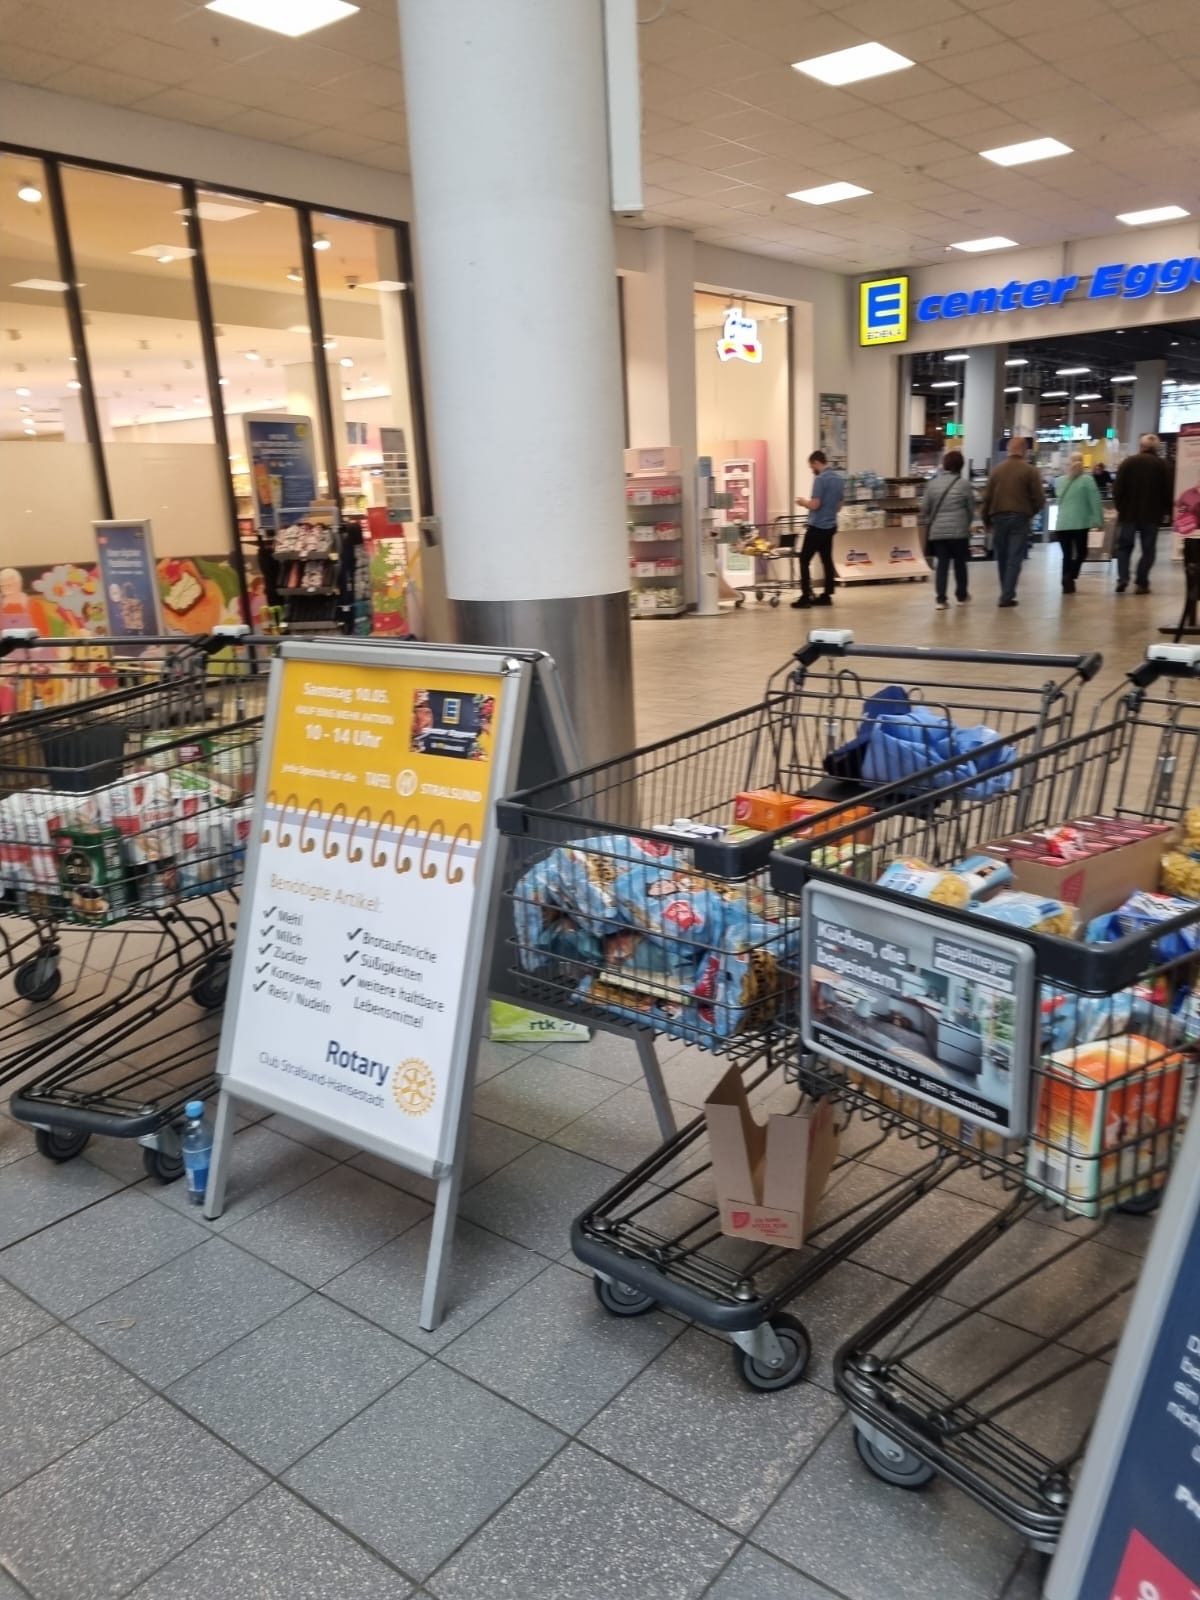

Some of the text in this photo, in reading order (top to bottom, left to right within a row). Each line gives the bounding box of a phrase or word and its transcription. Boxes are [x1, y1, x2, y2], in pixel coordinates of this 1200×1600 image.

[868, 283, 900, 328] E
[917, 275, 1077, 321] center
[304, 682, 353, 703] Samstag
[305, 724, 322, 741] 10
[332, 728, 350, 744] 14
[352, 729, 383, 748] Uhr
[278, 910, 304, 926] Mehl
[276, 929, 303, 945] Milch
[362, 931, 438, 964] Brotaufstriche
[817, 920, 906, 966] Küchen, die
[273, 946, 308, 965] Zucker
[360, 953, 424, 982] Süßigkeiten
[816, 945, 901, 993] begeistern.
[935, 942, 1014, 976] aspelmeyer
[271, 965, 322, 990] Konserven
[296, 992, 332, 1014] Nudeln
[357, 977, 446, 1013] weitere haltbare
[353, 996, 425, 1029] Lebensmittel
[259, 1050, 280, 1069] Club
[325, 1039, 390, 1087] Rotary
